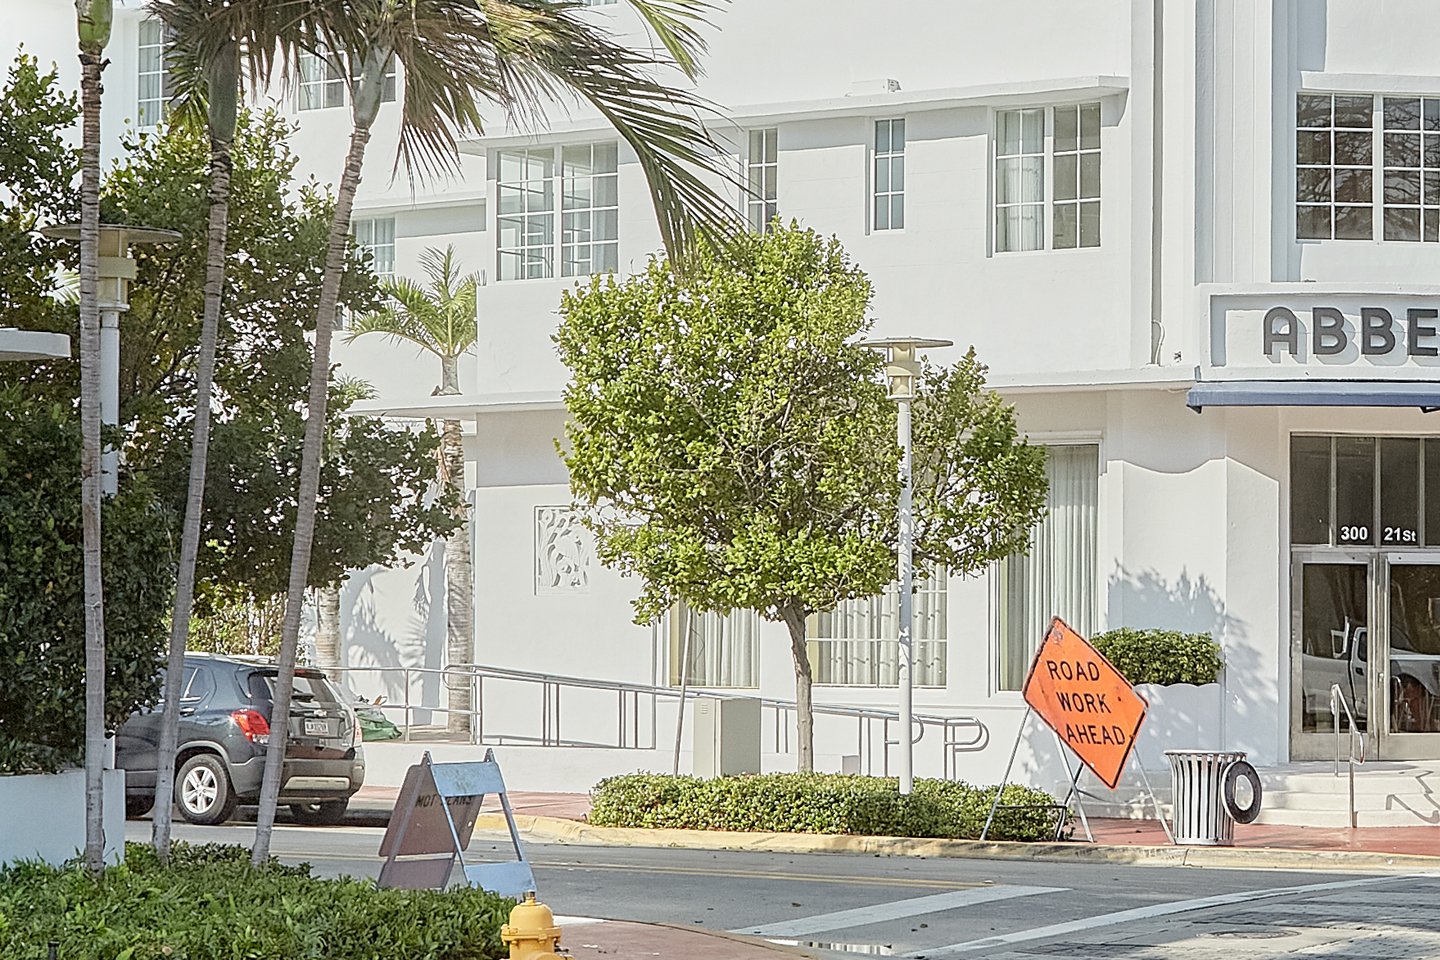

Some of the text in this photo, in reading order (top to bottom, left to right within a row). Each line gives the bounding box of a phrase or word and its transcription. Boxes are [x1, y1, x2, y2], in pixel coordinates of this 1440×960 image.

[1340, 526, 1368, 541] 300
[1046, 660, 1101, 681] ROAD
[1056, 691, 1112, 714] WORK
[1066, 723, 1126, 745] AHEAD
[415, 793, 438, 808] MOT
